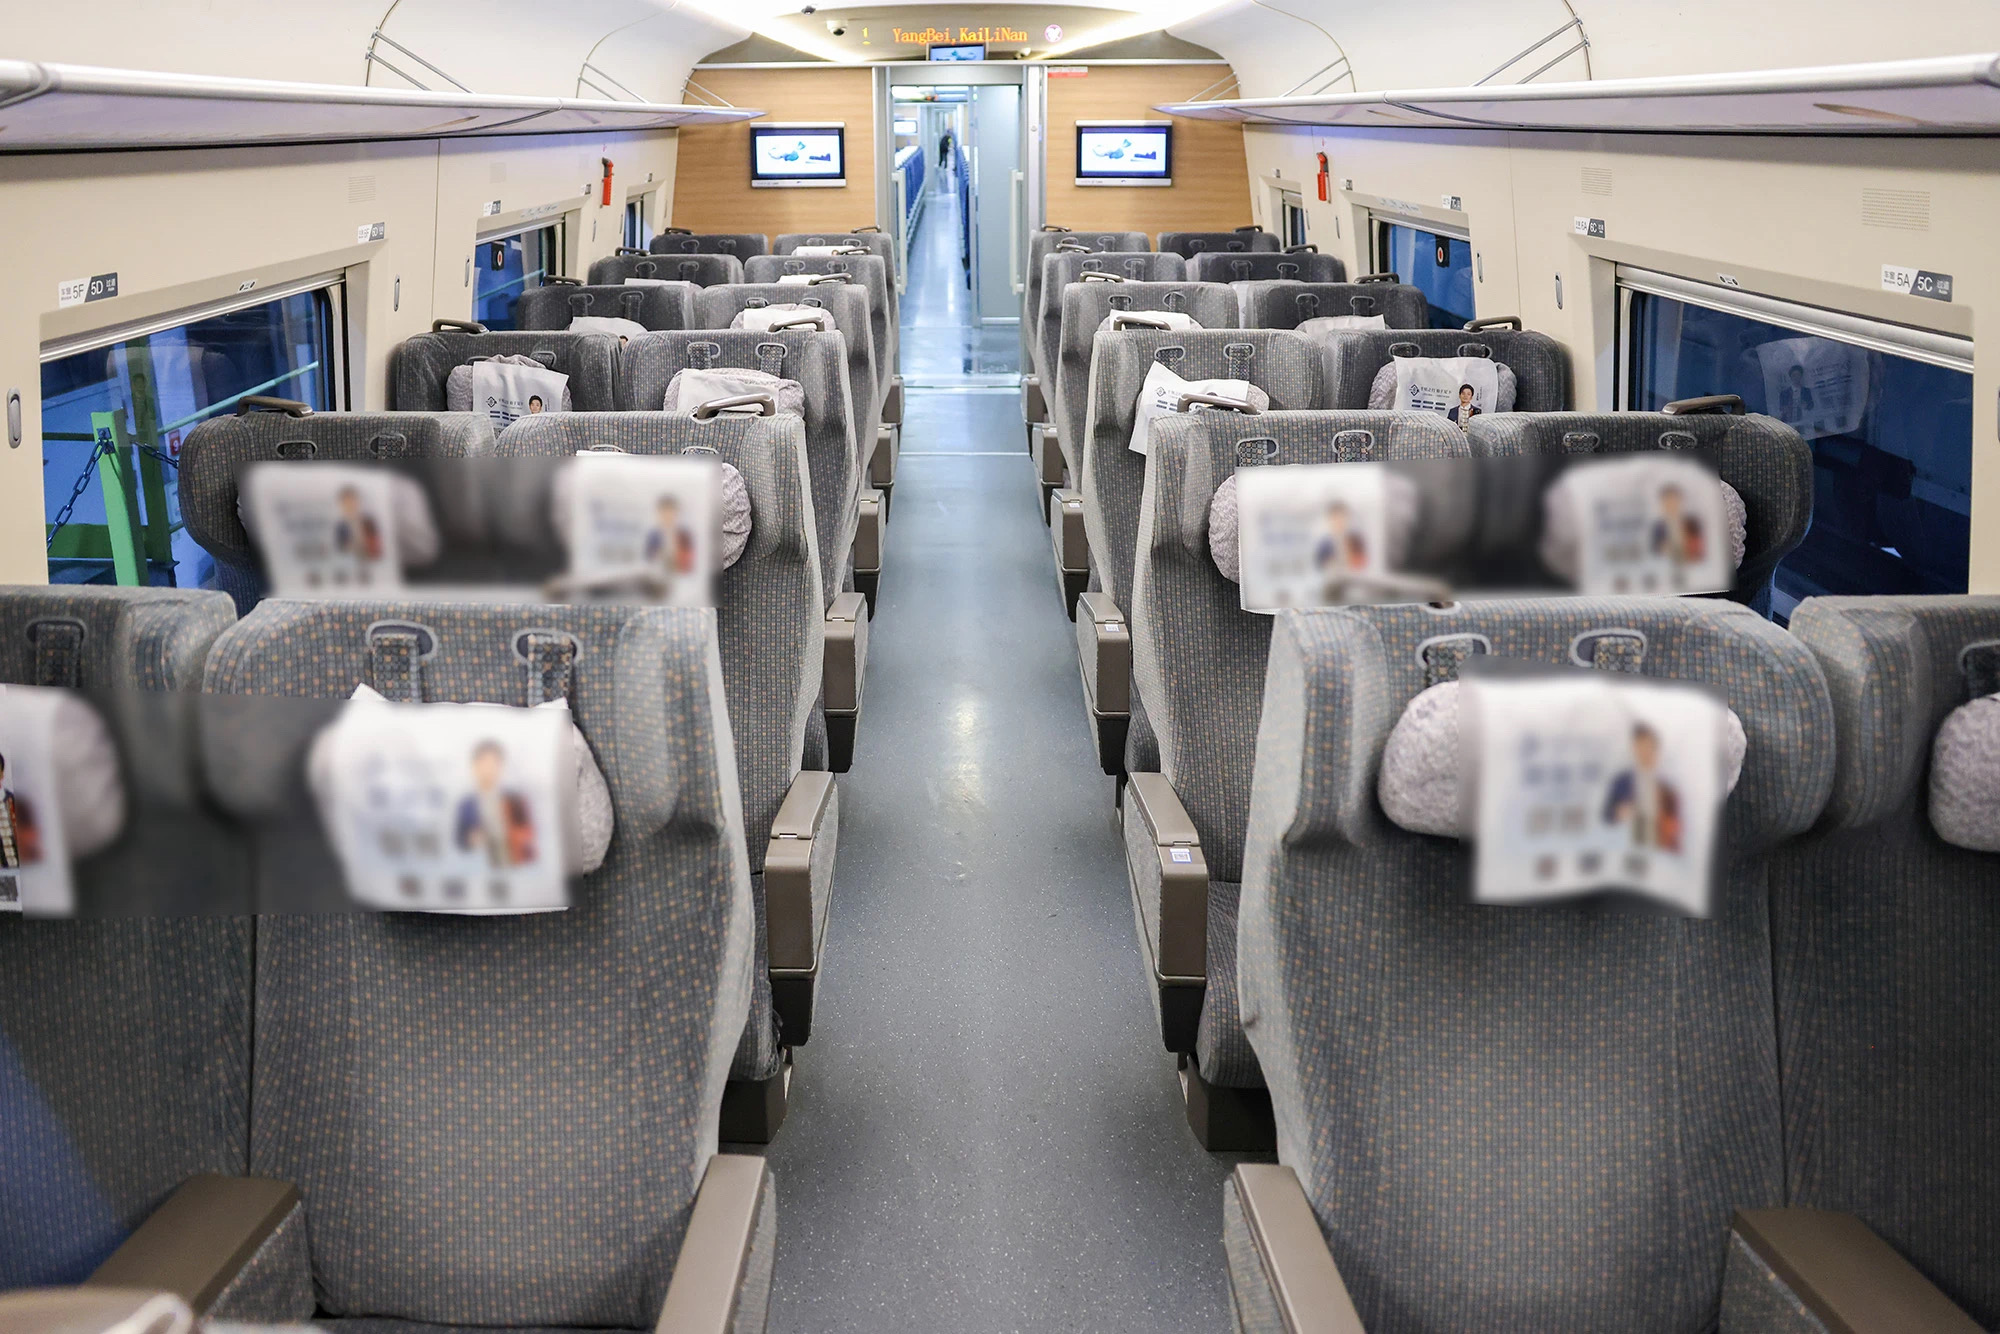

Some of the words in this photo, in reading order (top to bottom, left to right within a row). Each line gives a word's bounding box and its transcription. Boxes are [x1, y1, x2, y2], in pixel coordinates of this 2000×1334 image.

[73, 283, 84, 299] 5F
[91, 280, 104, 296] 5D
[1897, 272, 1910, 288] 5A
[1917, 276, 1933, 292] 5C
